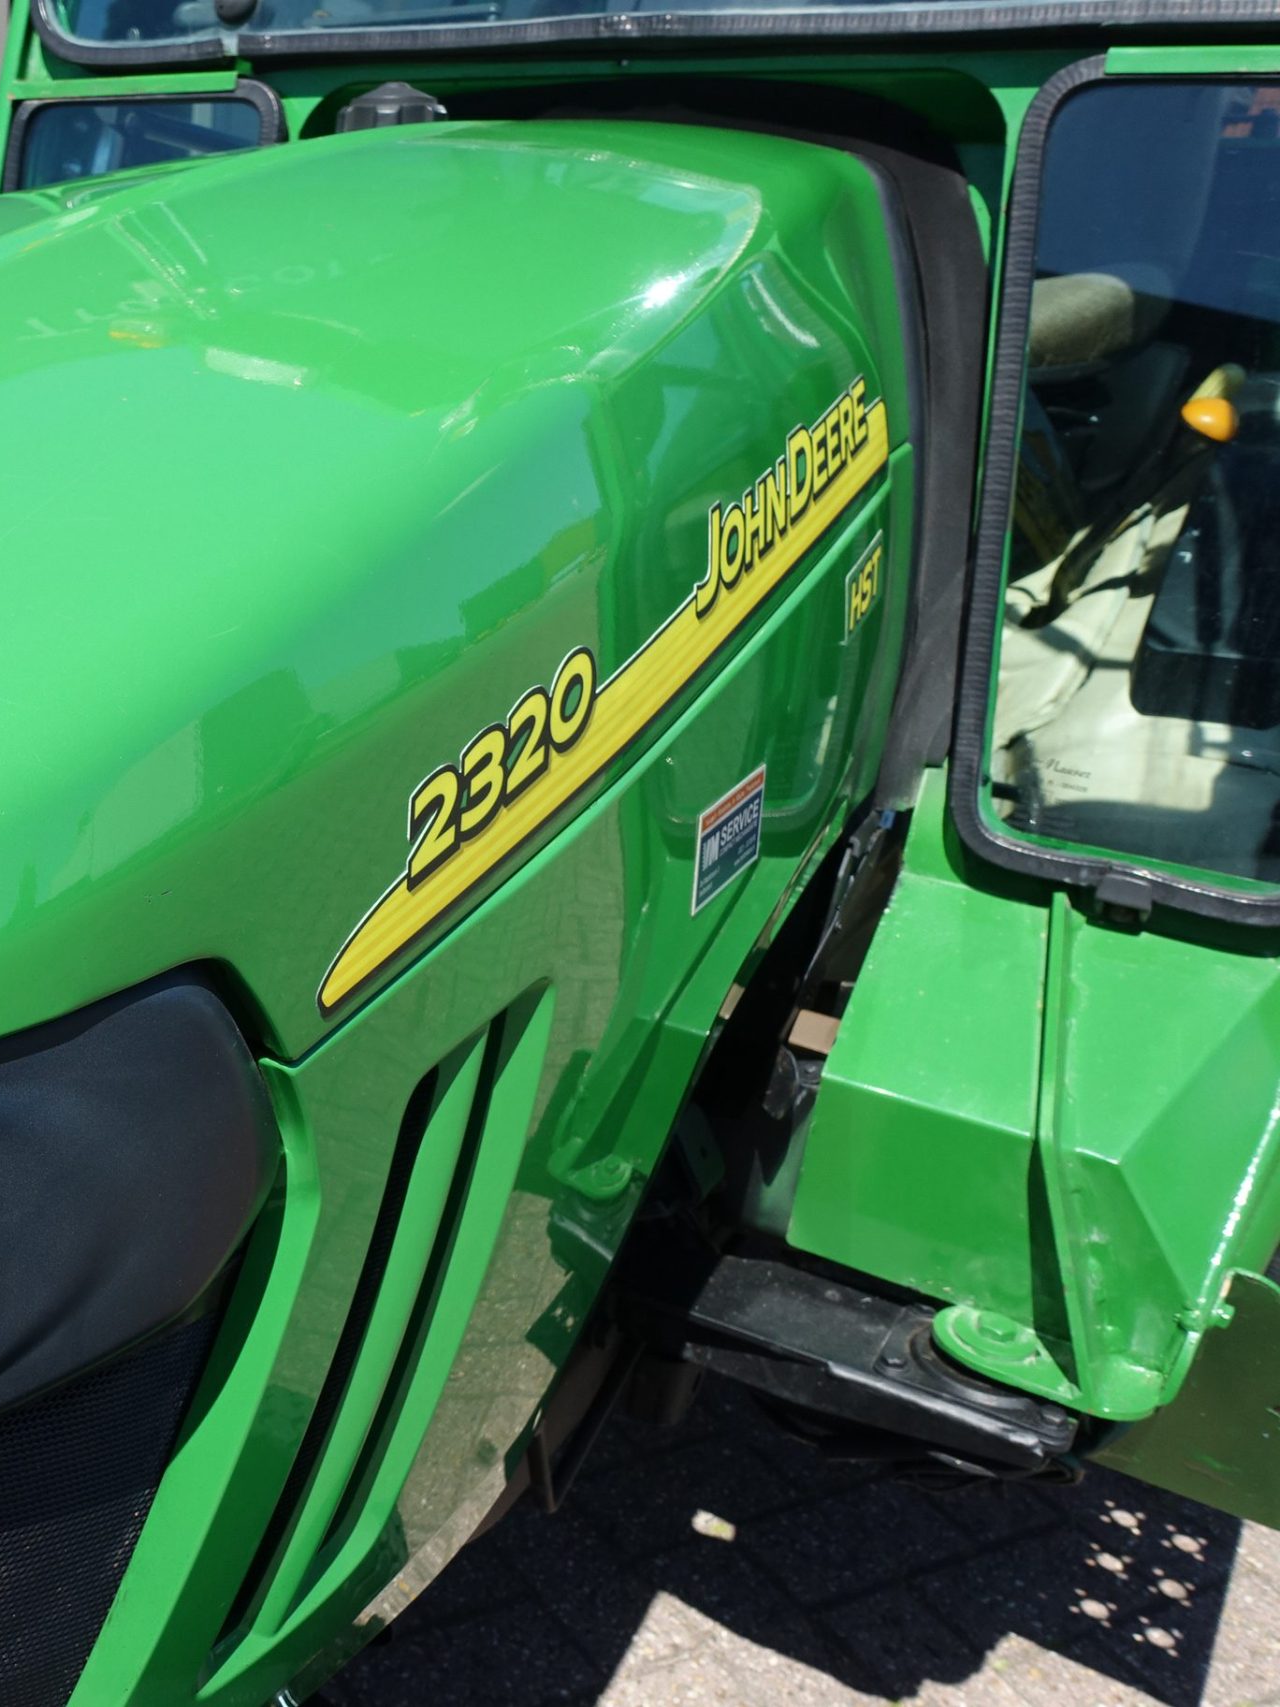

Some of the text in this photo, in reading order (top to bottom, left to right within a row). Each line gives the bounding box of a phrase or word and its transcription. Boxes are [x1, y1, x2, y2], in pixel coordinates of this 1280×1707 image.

[695, 376, 869, 618] JOHN DEERE
[849, 545, 882, 633] HST
[407, 645, 597, 890] 2320
[720, 797, 760, 847] SERVICE
